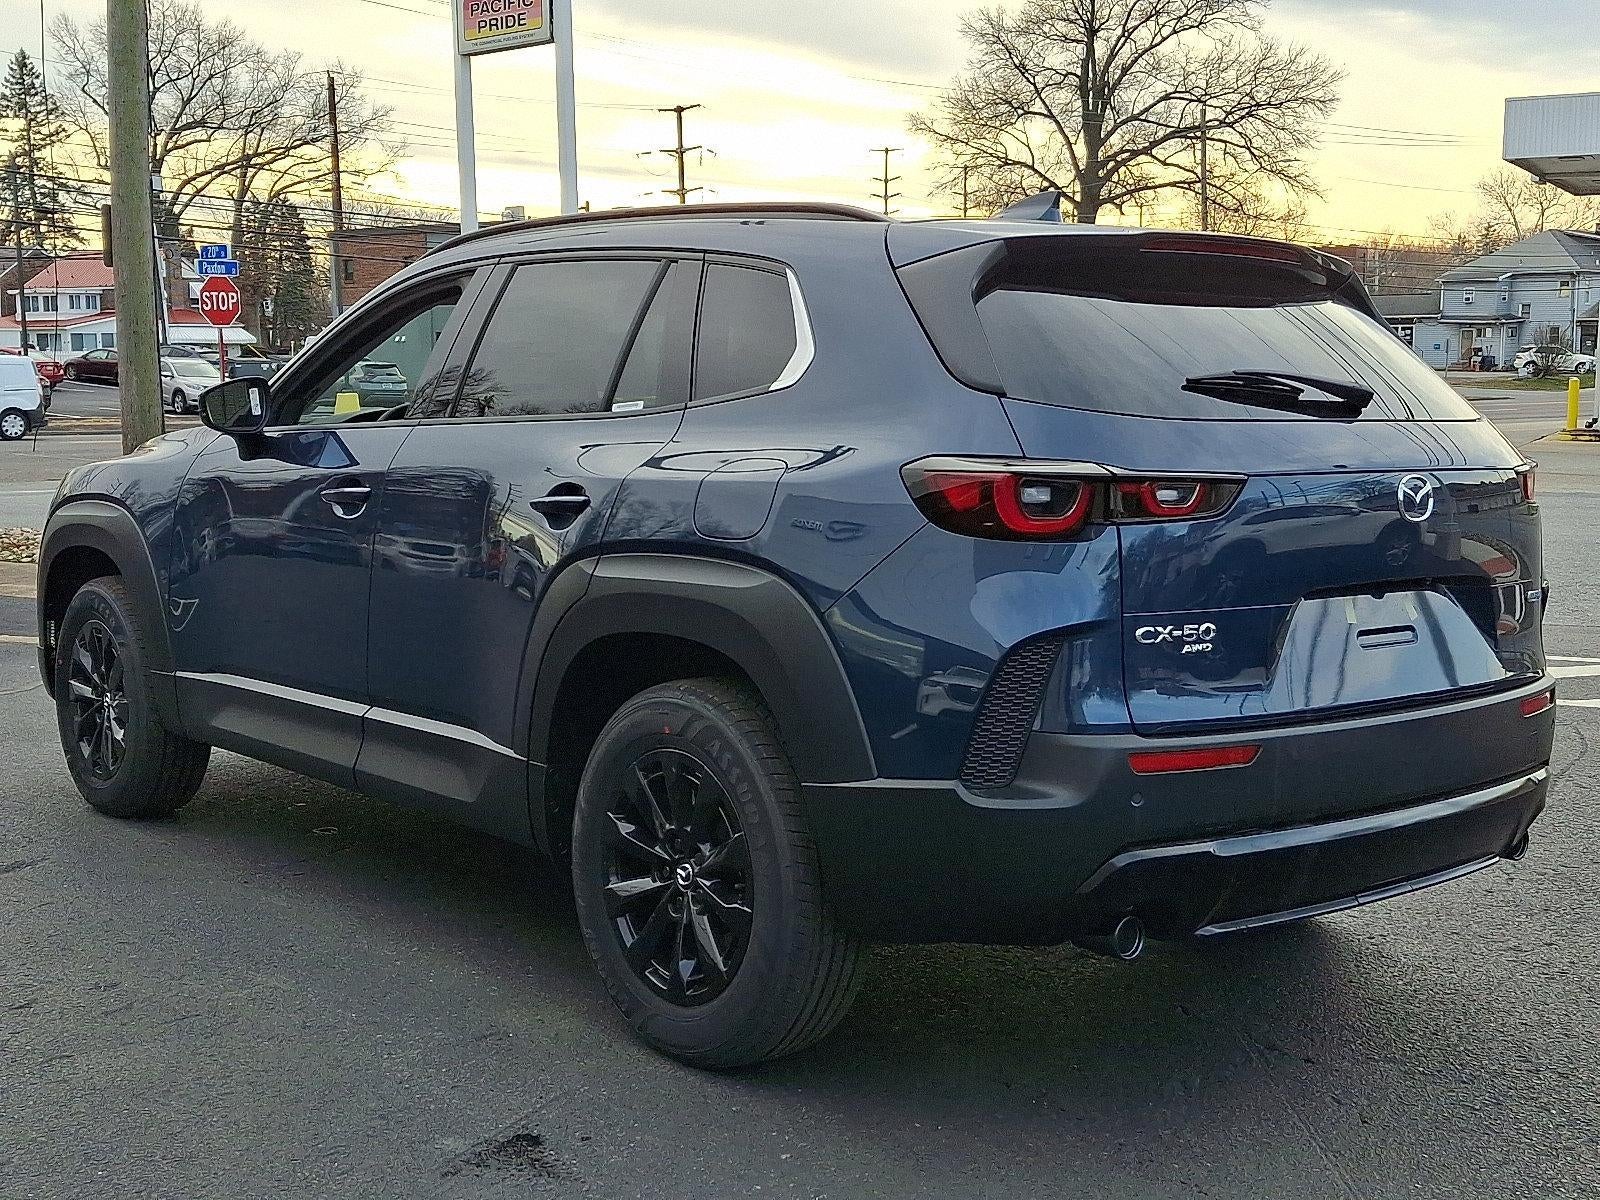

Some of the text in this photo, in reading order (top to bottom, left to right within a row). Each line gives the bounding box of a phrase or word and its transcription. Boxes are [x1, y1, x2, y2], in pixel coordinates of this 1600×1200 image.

[470, 0, 533, 17] PACIFIC
[477, 12, 527, 34] PRIDE
[202, 261, 226, 274] Paxton
[202, 291, 238, 311] STOP
[1135, 622, 1217, 644] CX-50
[1180, 642, 1213, 654] AWD
